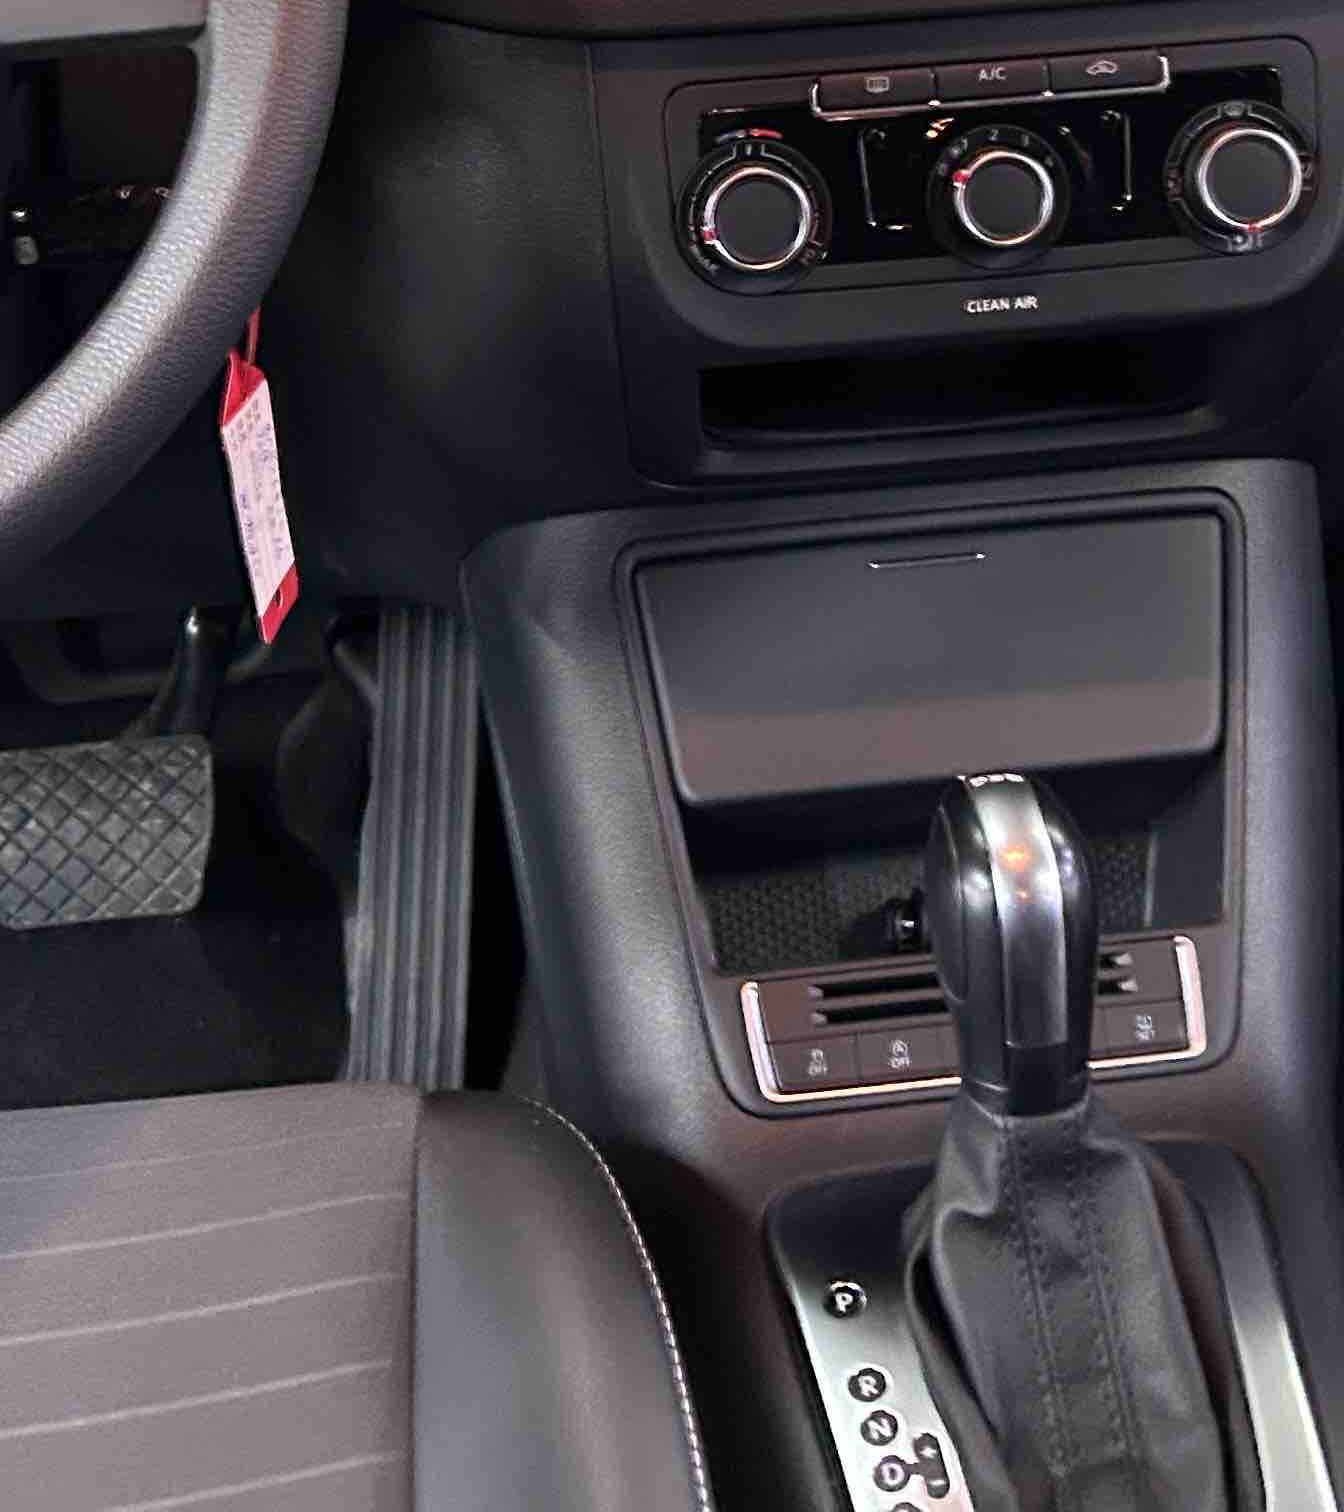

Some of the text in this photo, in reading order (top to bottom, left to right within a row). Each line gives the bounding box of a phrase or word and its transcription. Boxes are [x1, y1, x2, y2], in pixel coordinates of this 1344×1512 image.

[977, 66, 1007, 81] A/C
[988, 128, 1000, 142] 2
[966, 294, 1039, 313] CLEAN AIR
[836, 1292, 854, 1313] P
[857, 1374, 879, 1397] R
[866, 1417, 895, 1439] N
[881, 1459, 907, 1482] D
